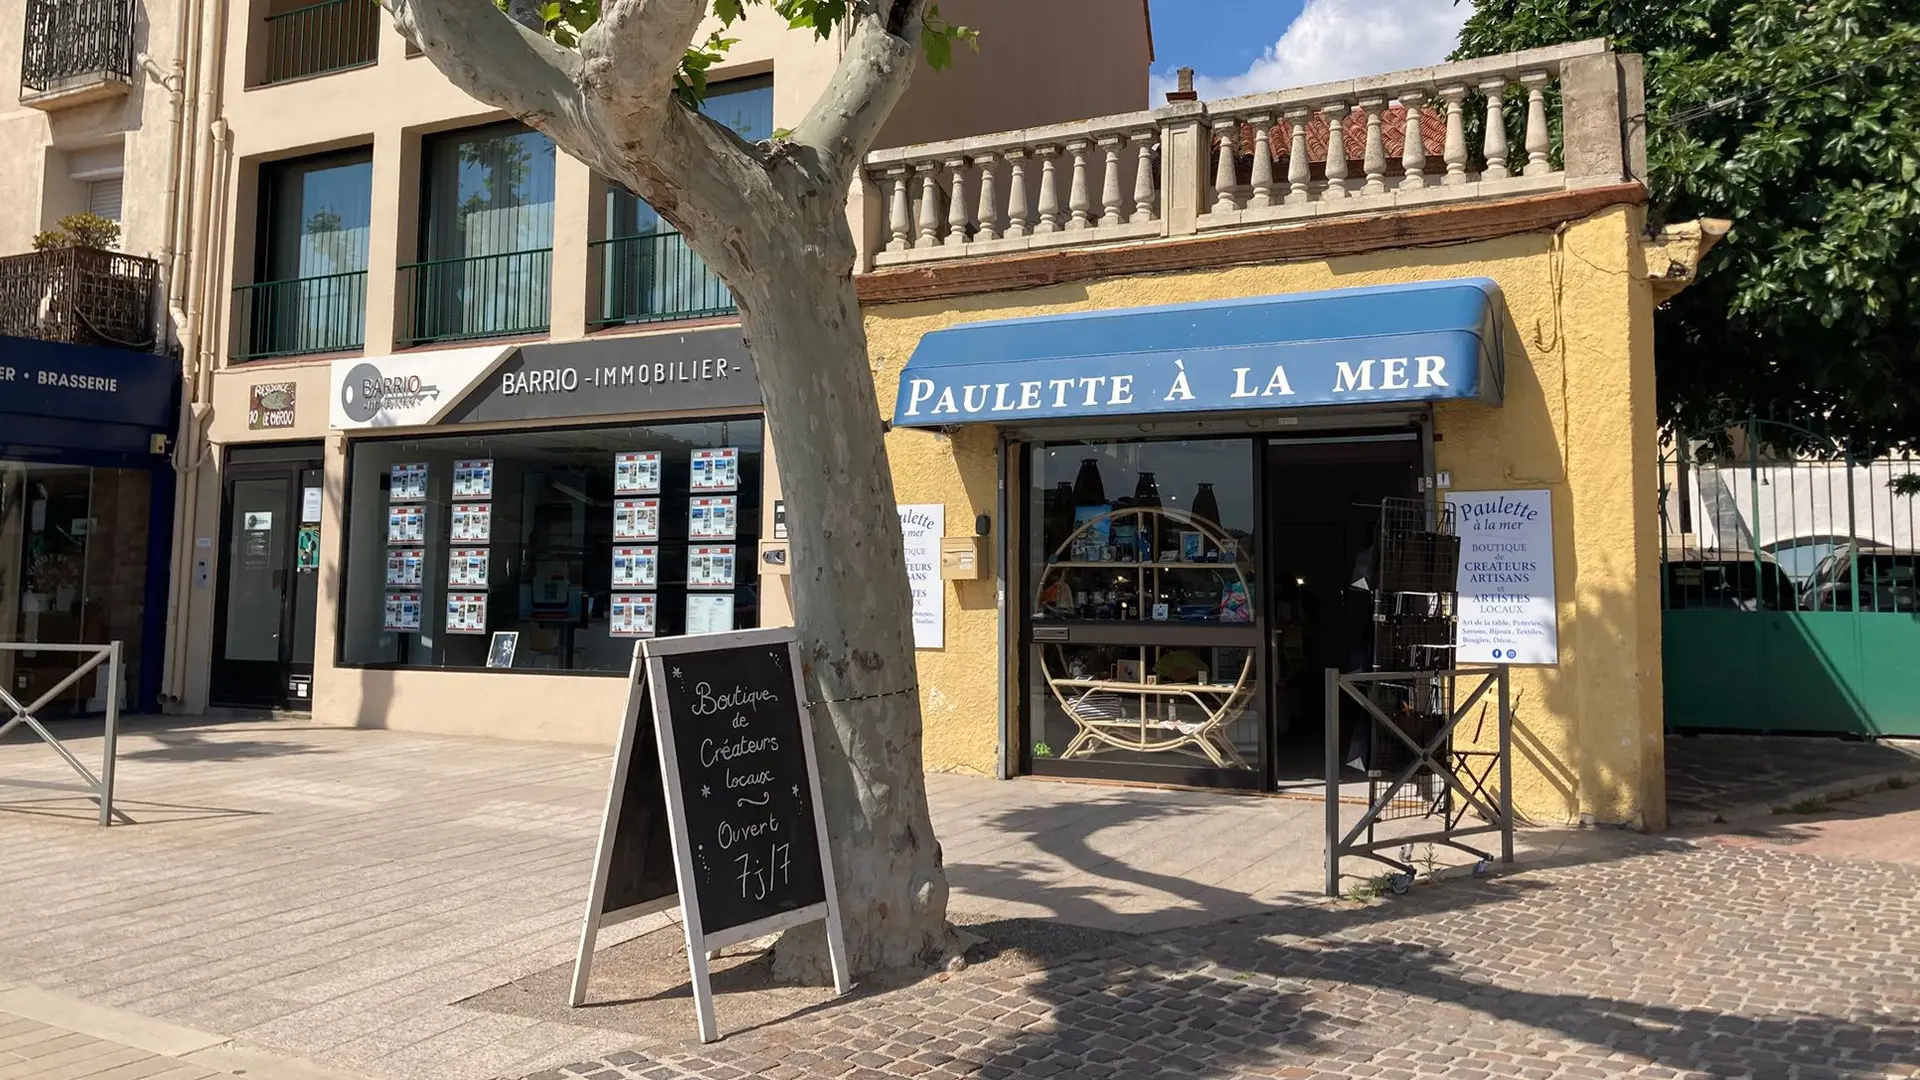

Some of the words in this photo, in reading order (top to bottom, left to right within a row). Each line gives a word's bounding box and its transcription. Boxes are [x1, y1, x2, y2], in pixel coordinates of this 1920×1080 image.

[37, 370, 117, 392] BRASSERIE
[362, 375, 421, 399] BARRIO
[502, 368, 578, 395] BARRIO
[904, 374, 1134, 416] PAULETTE
[1164, 358, 1196, 401] À
[1231, 365, 1296, 398] LA
[1332, 355, 1450, 393] MER
[900, 509, 935, 529] ulette
[1461, 496, 1538, 521] Paulette
[1473, 519, 1481, 530] à
[1484, 519, 1496, 530] la
[1500, 521, 1524, 531] mer
[1472, 543, 1527, 553] BOUTIQUE
[1464, 561, 1536, 571] CREATEURS
[1469, 573, 1530, 583] ARTISANS
[1473, 593, 1531, 603] ARTISTES
[1480, 605, 1524, 613] LOCAUX
[691, 681, 778, 715] Boutique
[732, 712, 750, 729] de
[700, 735, 779, 768] Créateurs
[718, 813, 779, 849] Ouvert
[733, 842, 792, 900] 7j/7
